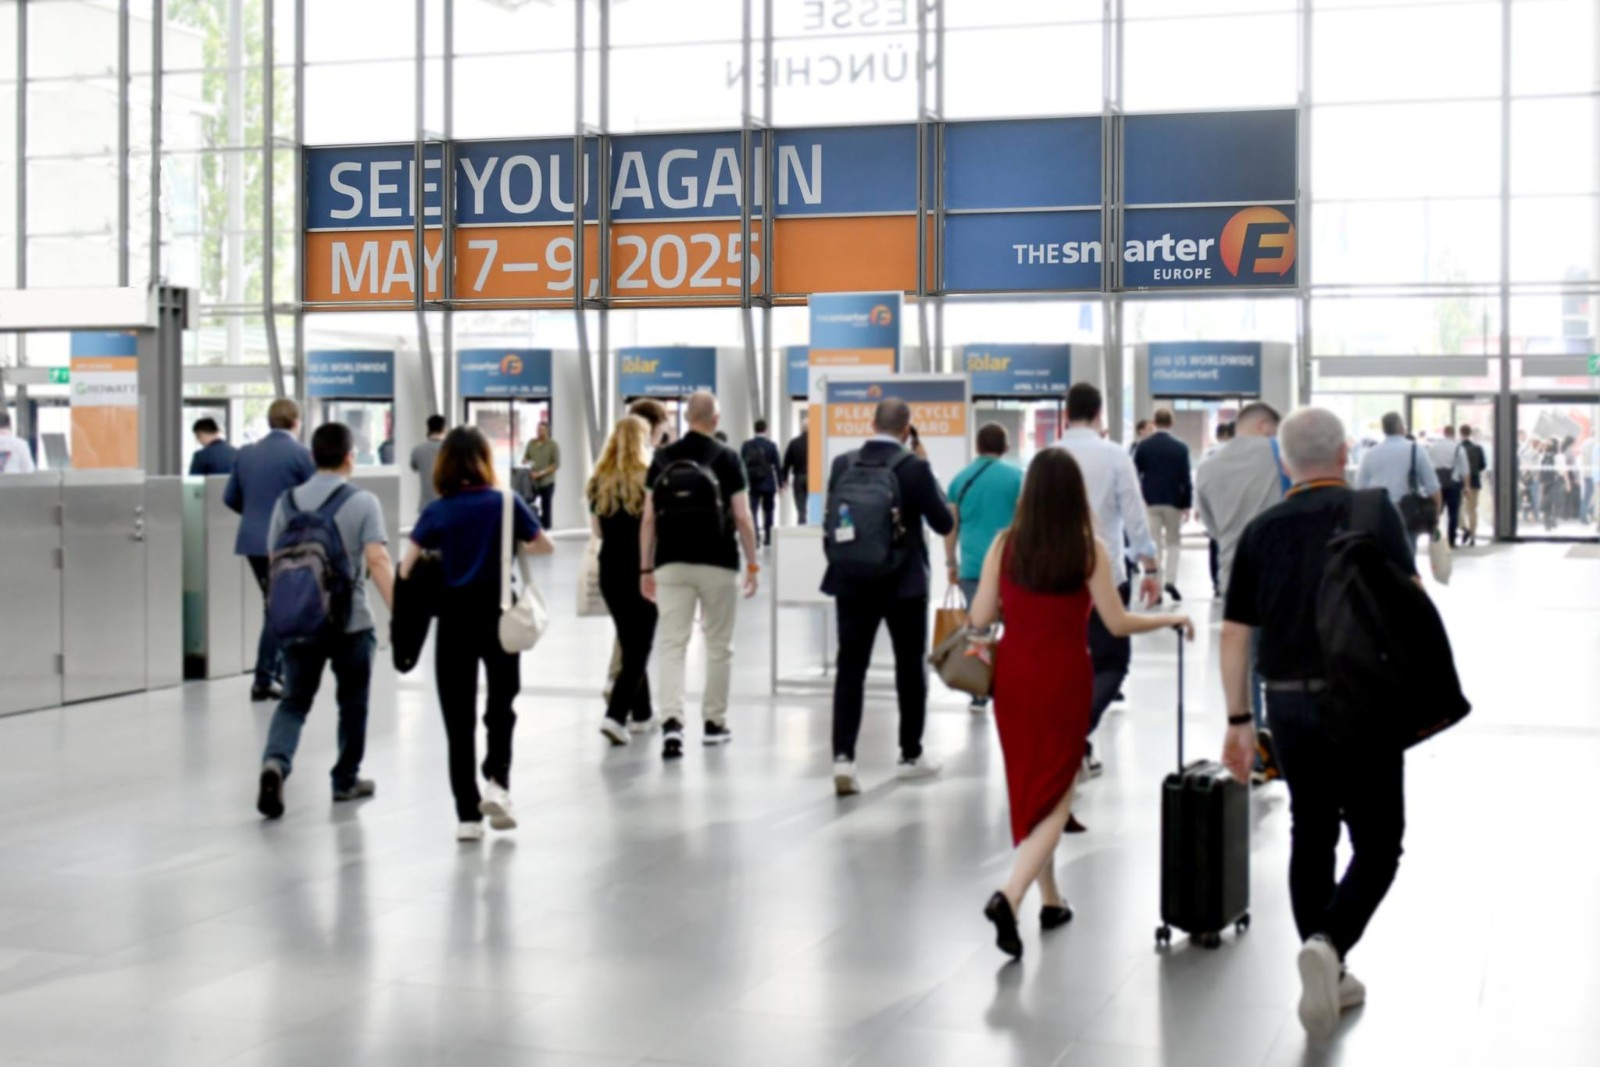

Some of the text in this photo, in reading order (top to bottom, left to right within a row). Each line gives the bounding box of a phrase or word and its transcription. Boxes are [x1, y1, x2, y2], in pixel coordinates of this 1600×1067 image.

[329, 144, 822, 219] SEE YOU AGAIN
[1013, 243, 1059, 264] THE
[1062, 232, 1215, 263] smarter
[331, 239, 444, 294] MAY
[616, 232, 761, 289] 2025
[1153, 268, 1212, 280] EUROPE
[1189, 354, 1254, 366] WORLDWIDE
[330, 362, 387, 373] WORLDWIDE
[834, 406, 876, 419] PLEA
